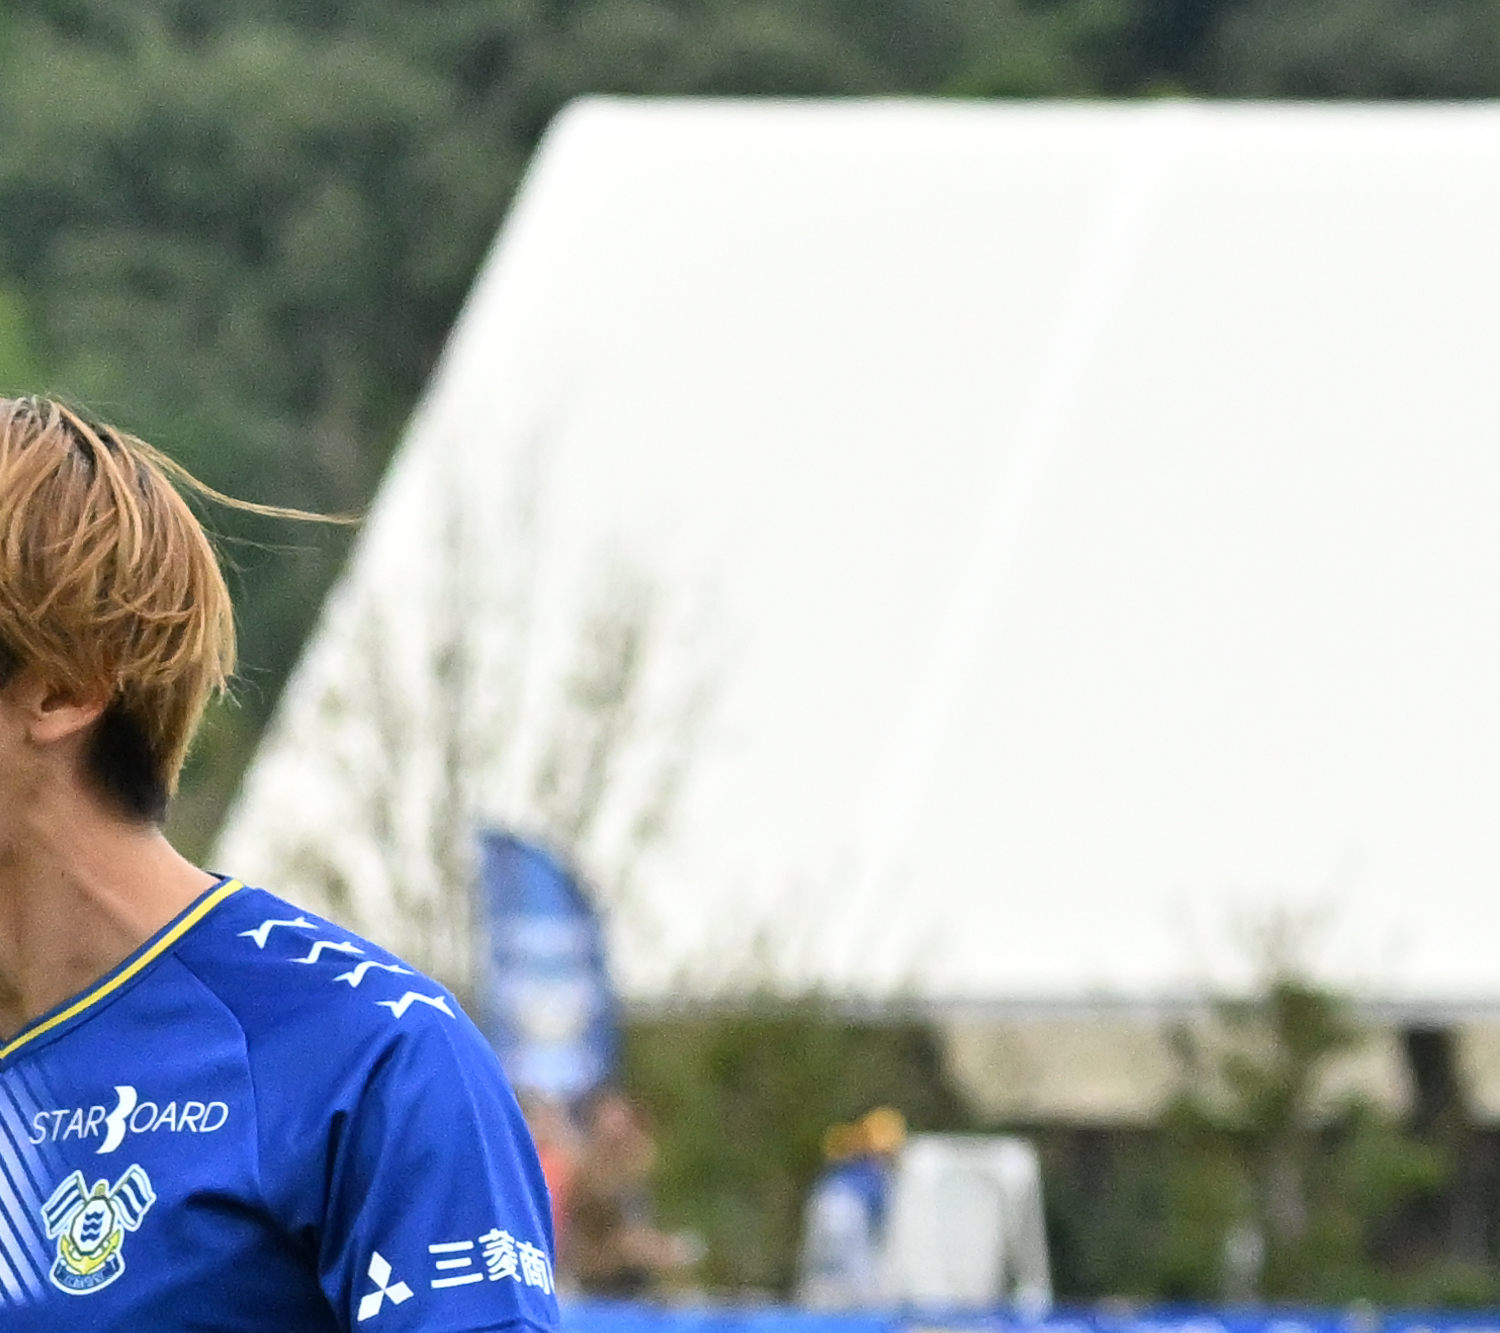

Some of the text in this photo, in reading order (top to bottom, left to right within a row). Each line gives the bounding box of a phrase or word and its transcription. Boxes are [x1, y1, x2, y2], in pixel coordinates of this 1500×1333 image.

[29, 1084, 230, 1155] STARBOARD
[428, 1227, 555, 1296] 三菱商
